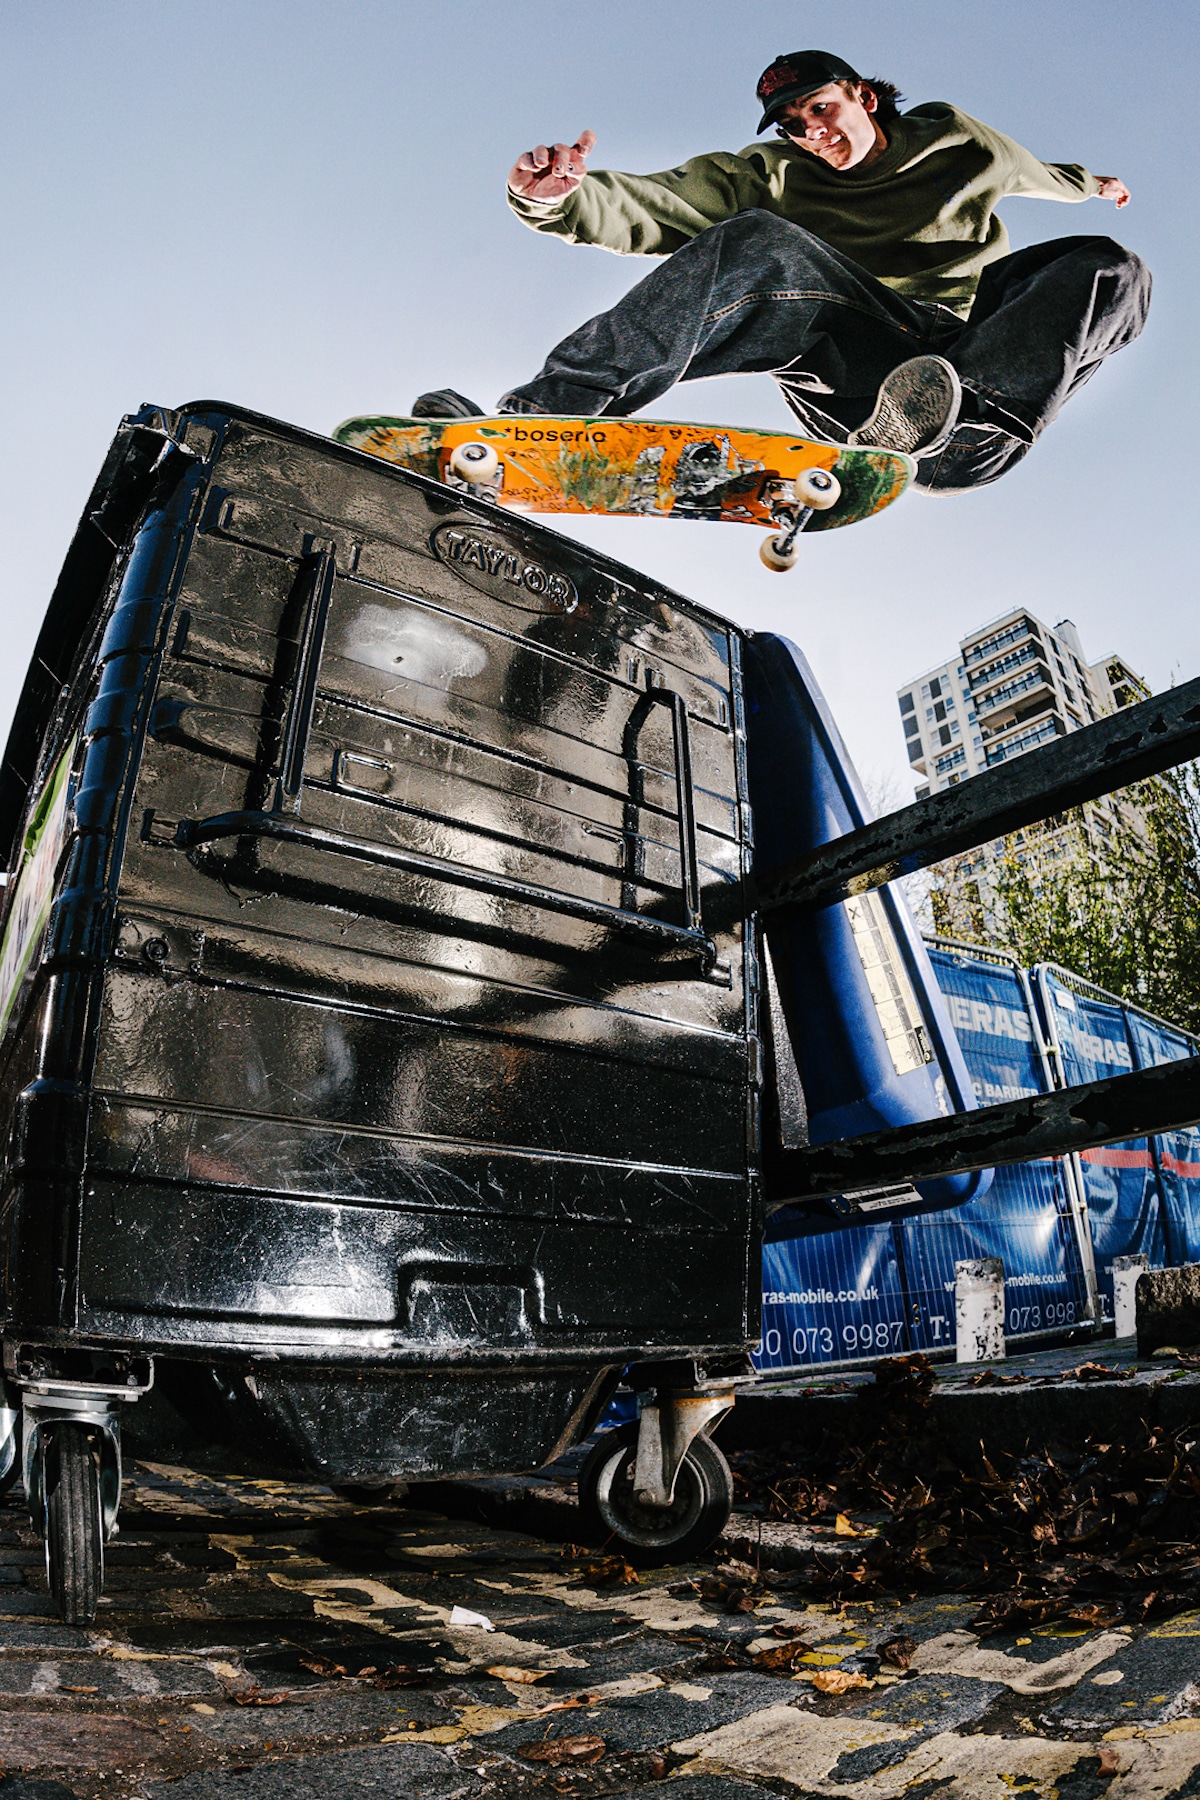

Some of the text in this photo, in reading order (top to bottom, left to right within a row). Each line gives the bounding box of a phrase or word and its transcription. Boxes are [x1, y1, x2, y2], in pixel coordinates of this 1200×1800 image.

[446, 530, 569, 606] TAYLOR
[762, 1285, 879, 1305] ras-mobile.co.uk
[1010, 1305, 1041, 1331] 073
[793, 1327, 834, 1354] 073
[842, 1321, 904, 1350] 9987
